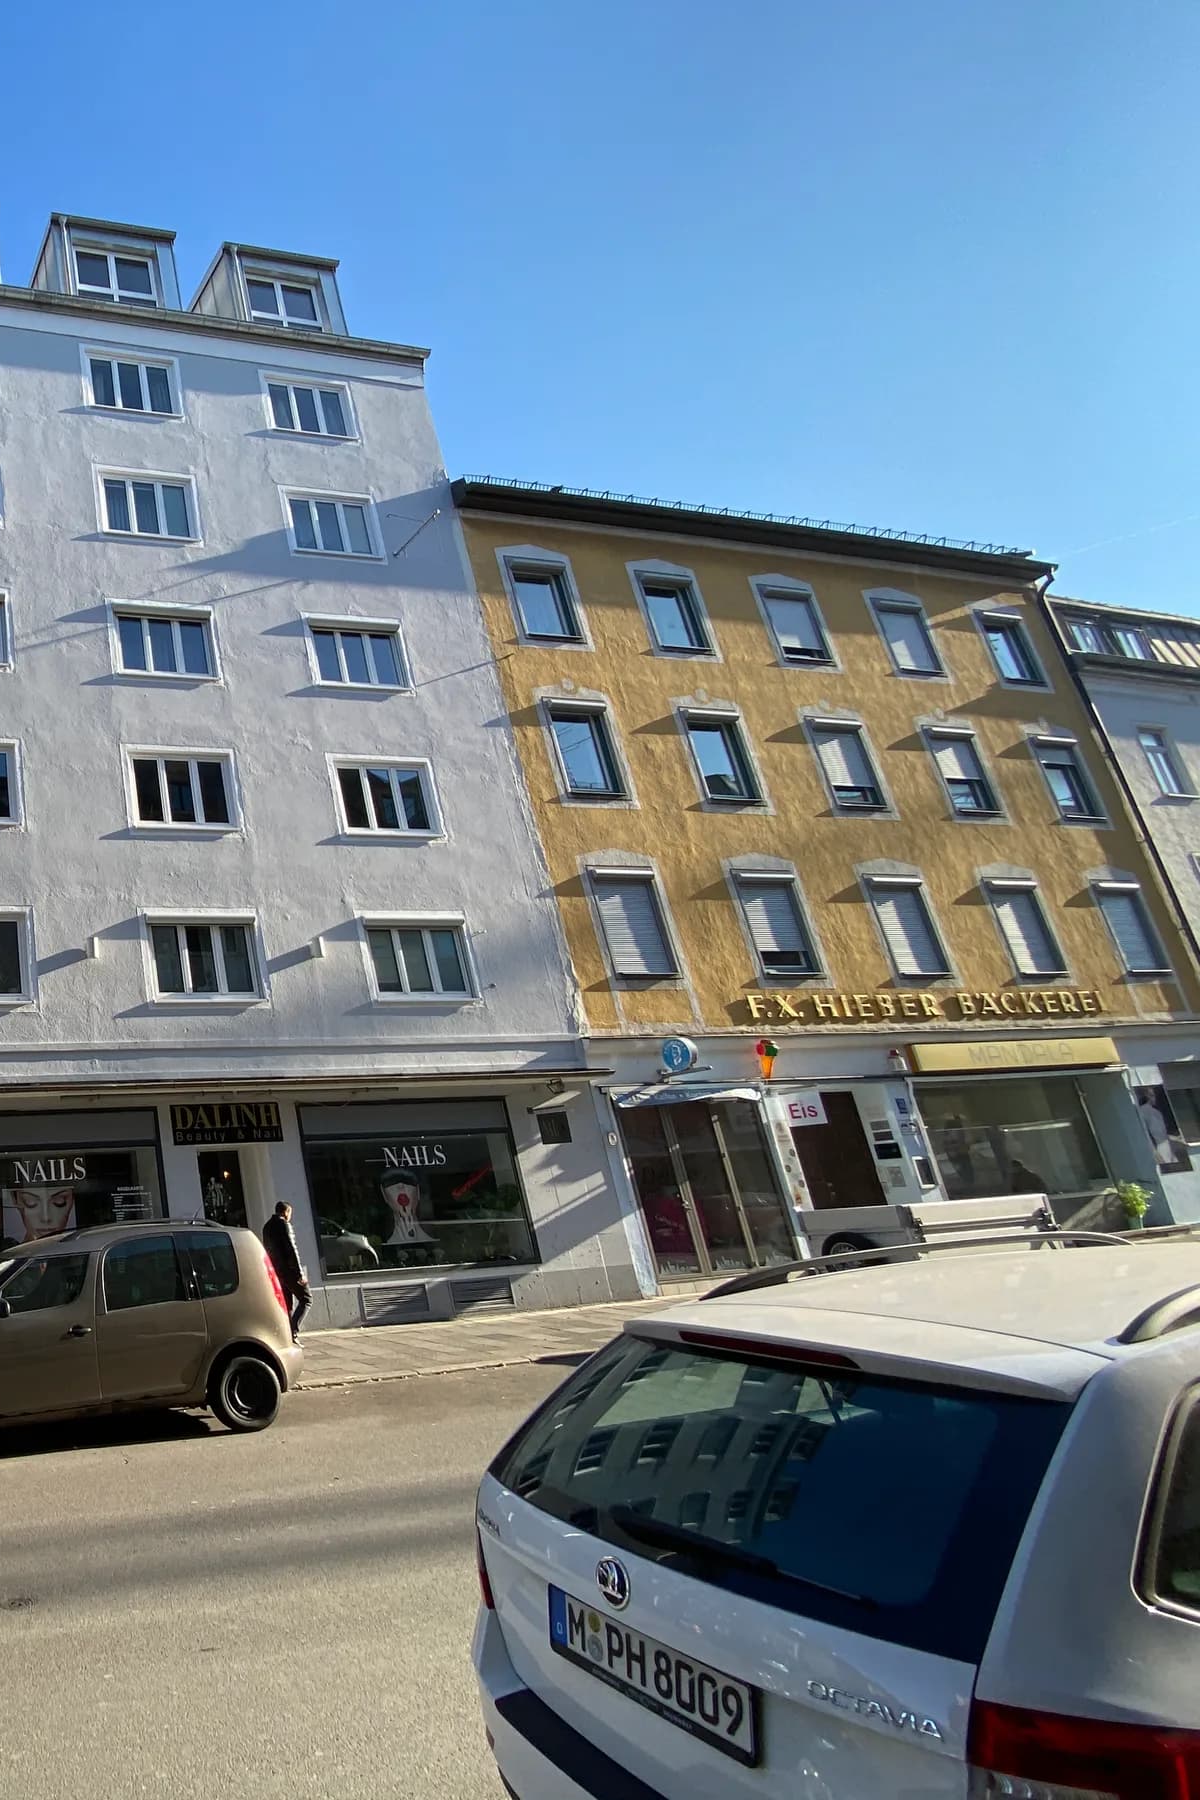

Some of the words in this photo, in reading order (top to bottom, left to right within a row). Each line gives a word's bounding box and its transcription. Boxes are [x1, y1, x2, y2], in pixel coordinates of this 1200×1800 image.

[747, 996, 805, 1019] F.X.
[813, 992, 946, 1018] HIEBER
[956, 989, 1108, 1015] BÄCKEREI
[967, 1042, 1073, 1066] MANDALA
[173, 1103, 280, 1129] DALINH
[788, 1102, 819, 1119] Eis
[175, 1130, 225, 1143] Beauty
[381, 1144, 447, 1168] NAILS
[13, 1157, 87, 1184] NAILS
[568, 1602, 586, 1652] M
[604, 1621, 648, 1688] PH
[653, 1649, 744, 1737] 8009
[806, 1679, 946, 1743] OCTAVIA
